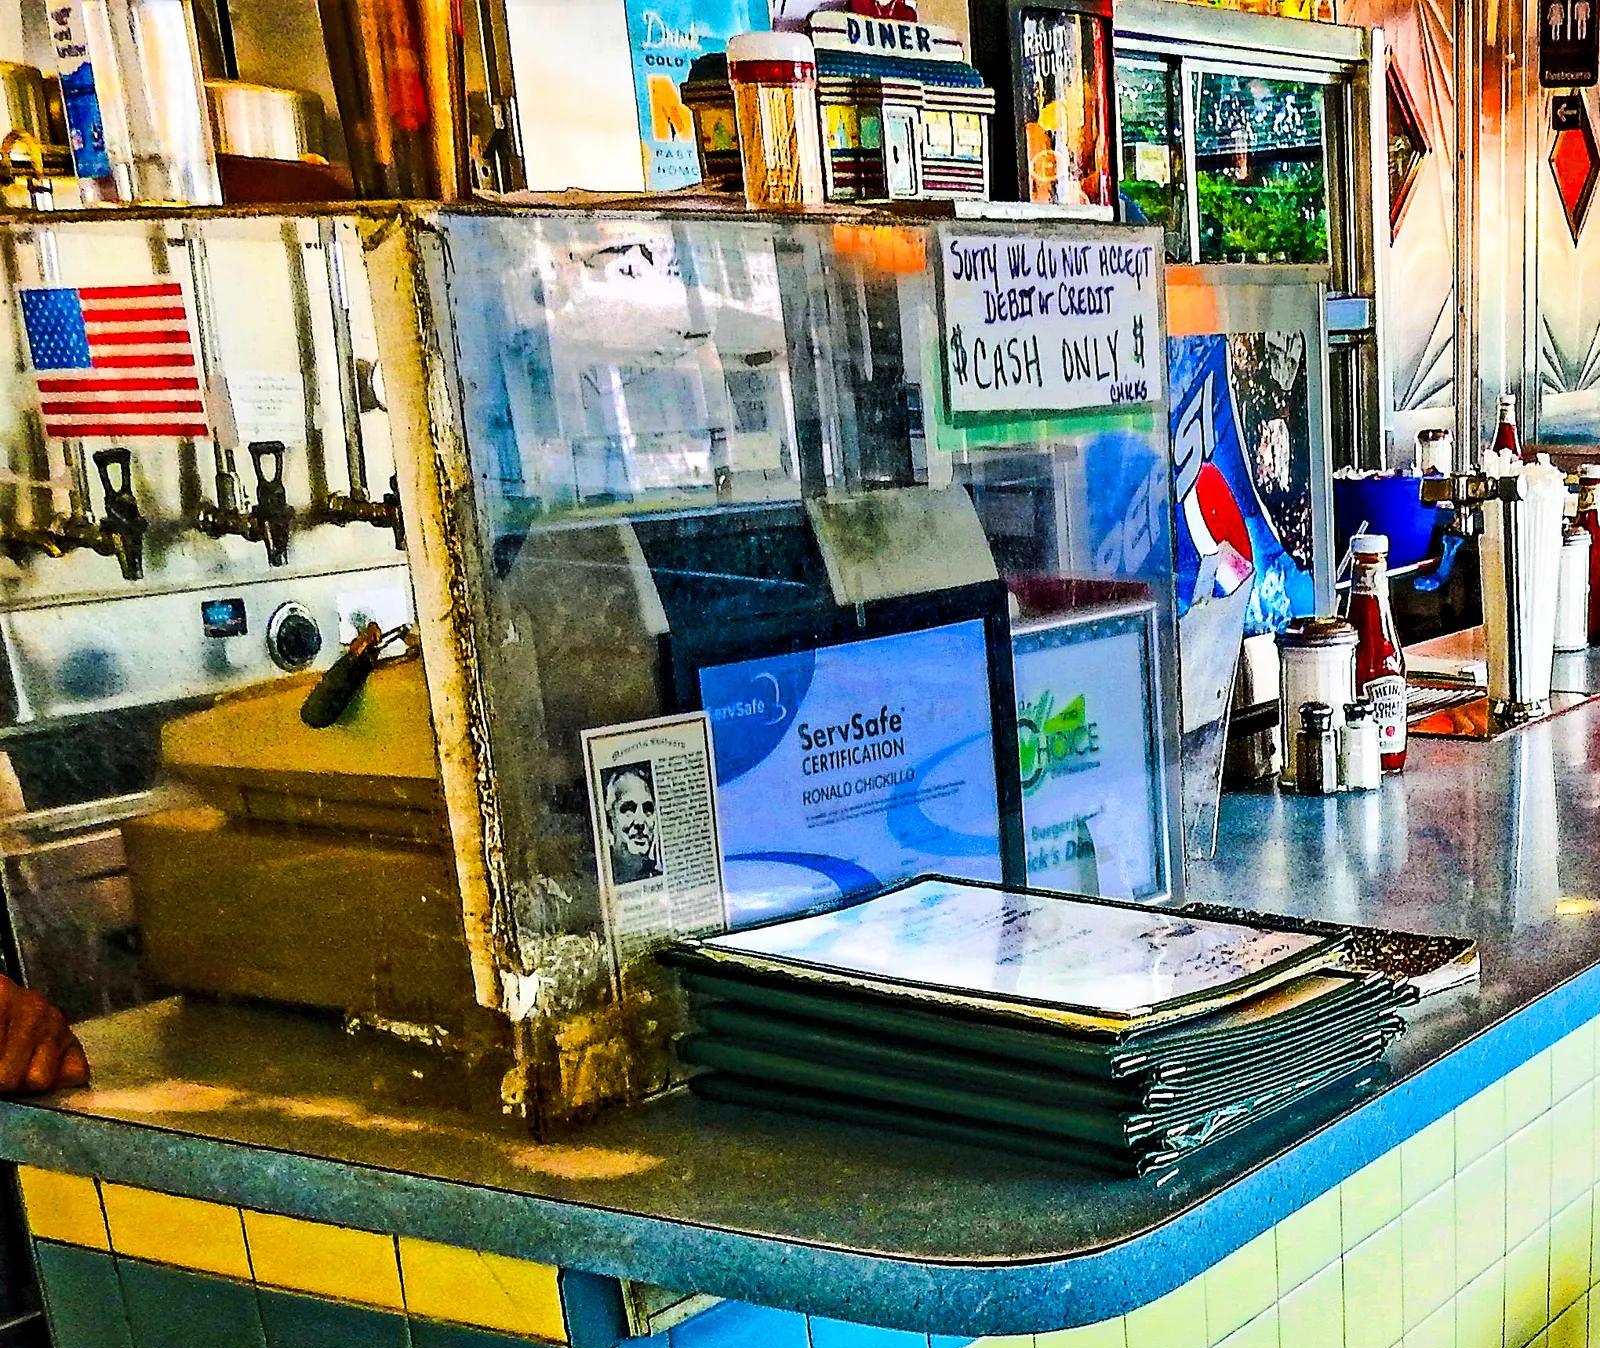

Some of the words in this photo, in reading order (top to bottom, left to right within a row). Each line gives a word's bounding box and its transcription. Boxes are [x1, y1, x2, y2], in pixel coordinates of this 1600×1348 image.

[847, 17, 934, 52] DINER
[645, 55, 684, 67] COLD
[951, 240, 999, 293] Sorry
[1062, 246, 1091, 277] NOT
[1100, 246, 1153, 291] ACCEPT
[984, 286, 1036, 323] DEBIT
[1058, 282, 1114, 316] CREDIT
[974, 334, 1042, 390] CASH
[1062, 330, 1118, 382] ONLY
[798, 705, 903, 751] ServSafe
[802, 737, 905, 776] CERTIFICATION
[855, 768, 915, 793] CHICKILLO
